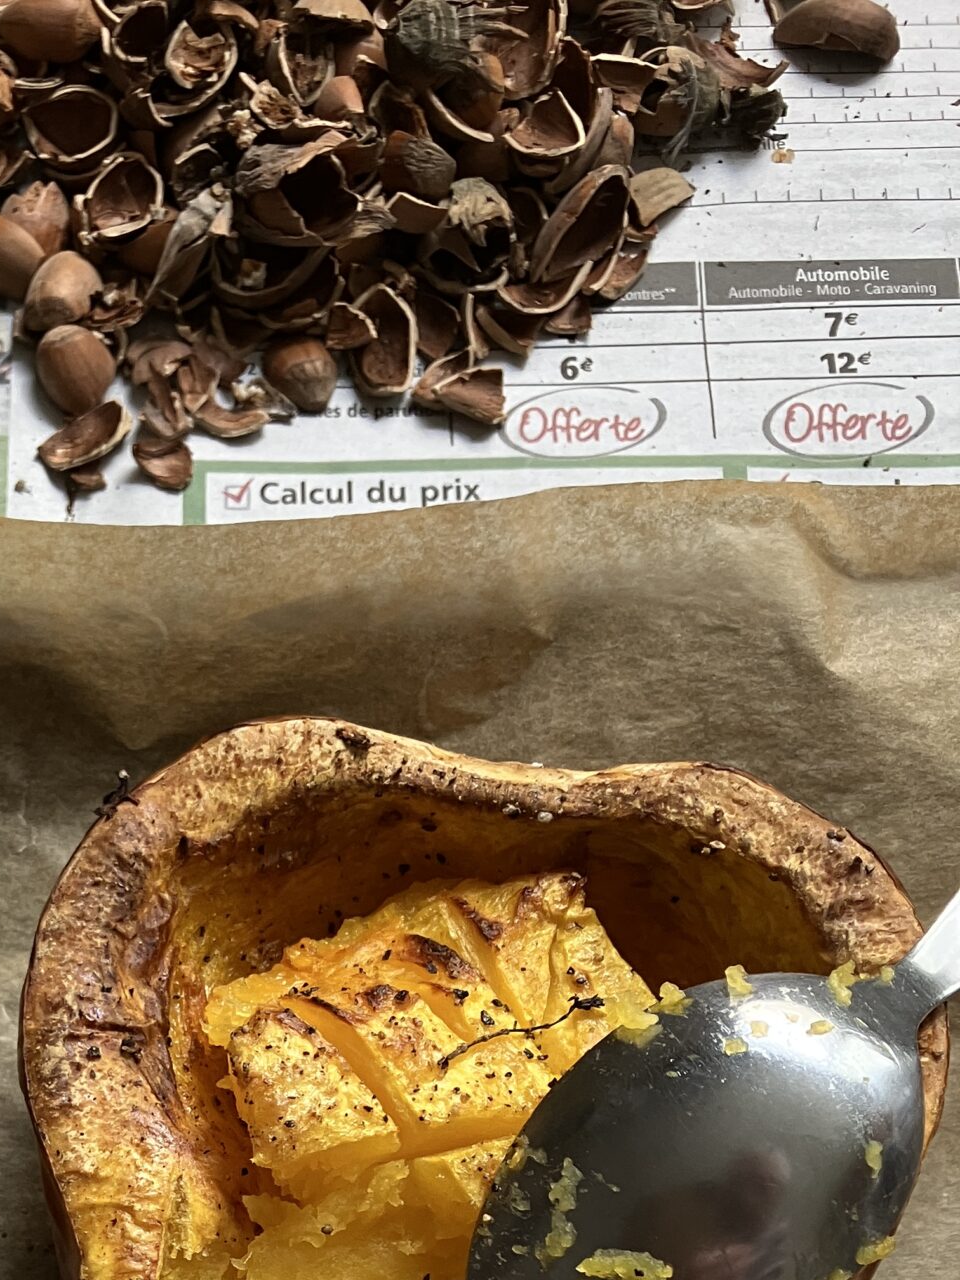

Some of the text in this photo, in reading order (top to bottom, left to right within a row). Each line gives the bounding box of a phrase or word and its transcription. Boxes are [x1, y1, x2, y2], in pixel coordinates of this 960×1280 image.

[795, 266, 890, 282] Automobile
[728, 284, 803, 299] Automobile
[816, 284, 851, 296] Moto
[864, 282, 937, 297] Caravaning
[824, 312, 858, 337] 7€
[560, 356, 593, 380] 6€
[820, 351, 871, 374] 12€
[519, 407, 645, 443] Offerte
[784, 402, 913, 443] Offerte
[259, 478, 480, 507] Calcul du prix
